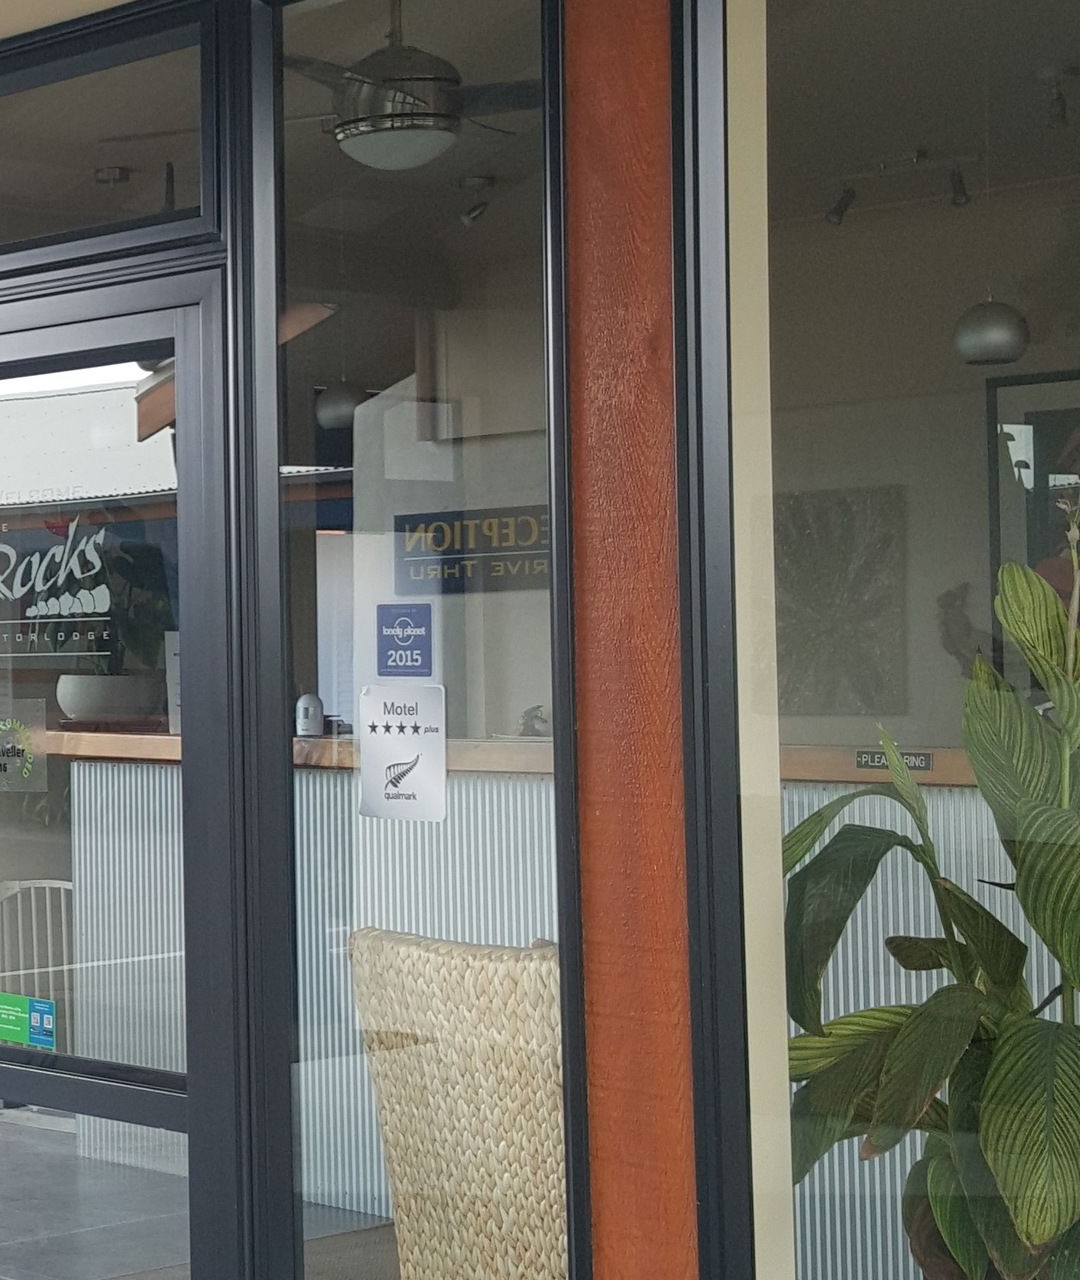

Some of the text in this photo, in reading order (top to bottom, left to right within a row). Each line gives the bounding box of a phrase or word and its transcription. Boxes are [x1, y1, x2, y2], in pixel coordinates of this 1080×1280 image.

[383, 625, 426, 638] lonely planet
[387, 650, 422, 666] 2015
[383, 701, 418, 716] Motel
[423, 725, 439, 734] plus
[861, 753, 888, 766] PLEA
[384, 791, 418, 801] qualmark
